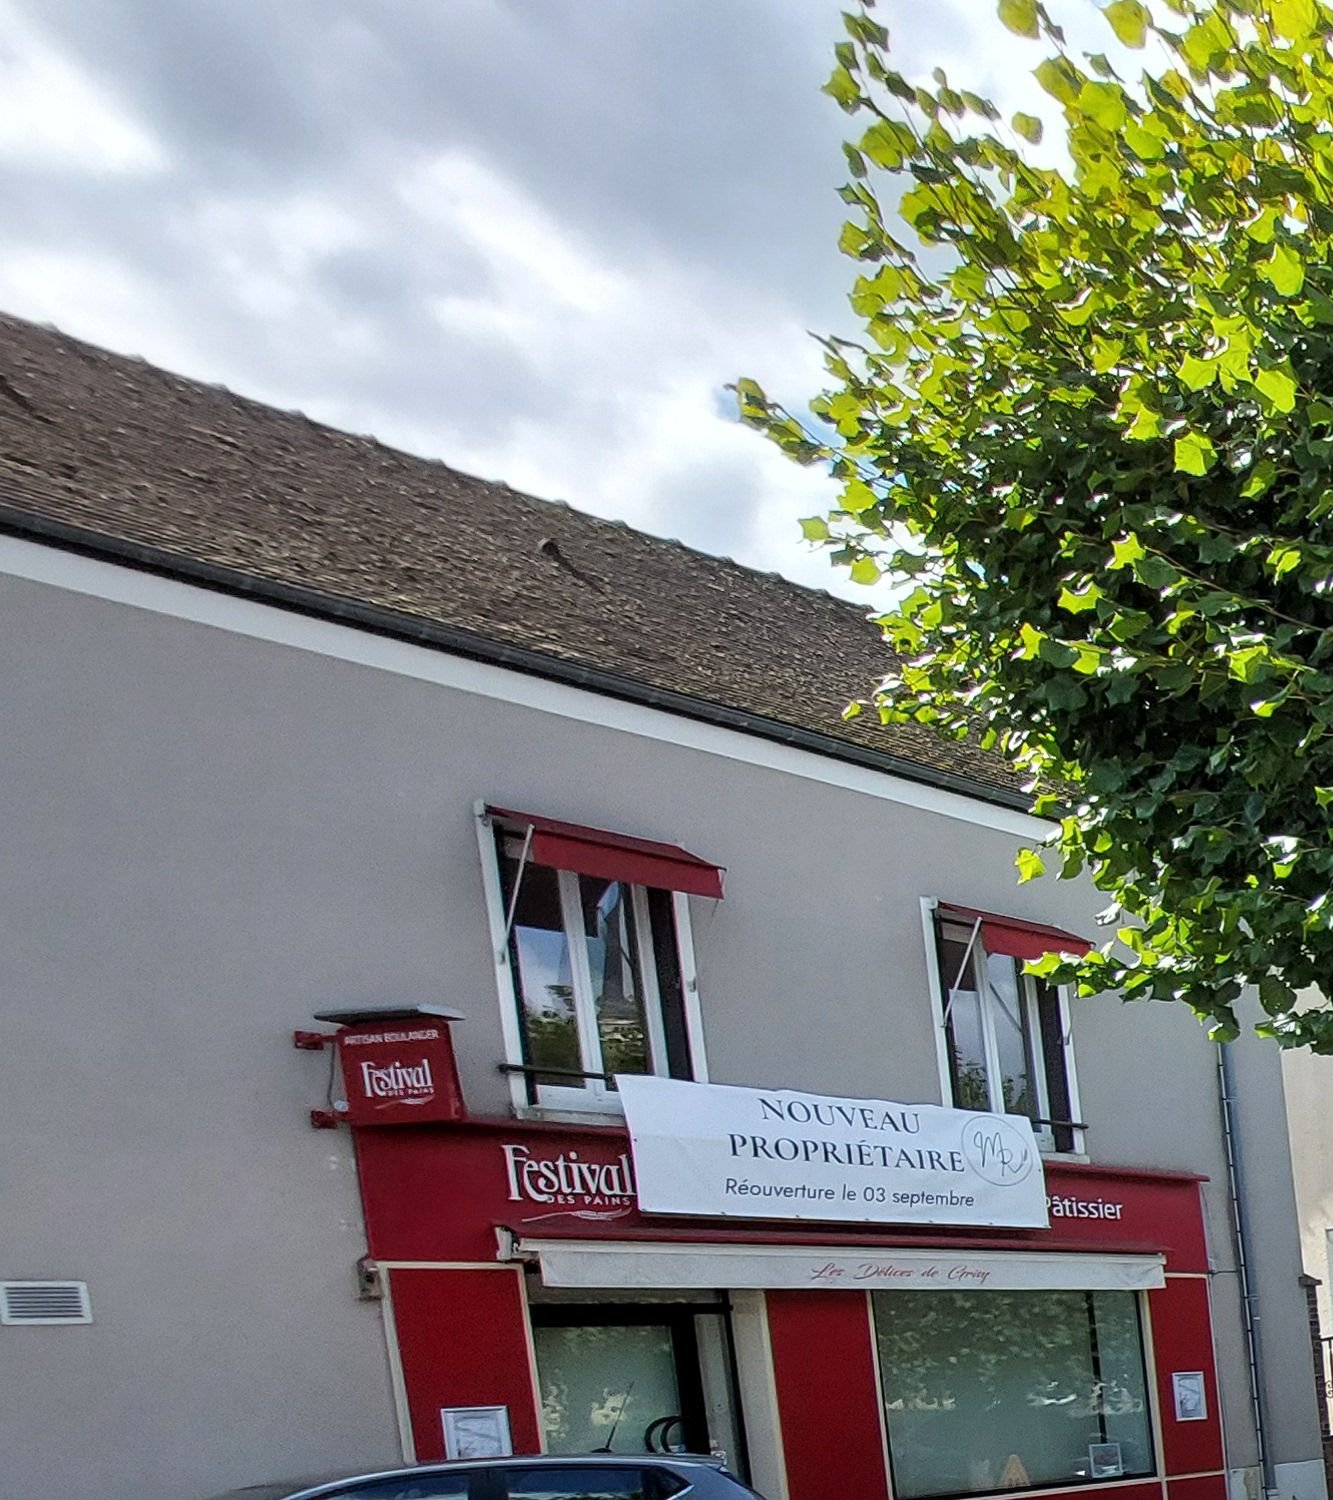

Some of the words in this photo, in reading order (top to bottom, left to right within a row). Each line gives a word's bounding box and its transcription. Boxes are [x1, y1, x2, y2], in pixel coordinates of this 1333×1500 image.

[345, 1034, 383, 1045] ARTISAN
[384, 1029, 439, 1043] BOULANGER
[360, 1058, 434, 1098] Festival
[758, 1098, 920, 1135] NOUVEAU
[728, 1133, 966, 1173] PROPRIÉTAIRE
[501, 1143, 637, 1202] Festival
[583, 1195, 632, 1207] PAINS
[725, 1178, 836, 1201] Réouverture
[842, 1183, 857, 1201] le
[863, 1186, 886, 1202] 03
[892, 1189, 975, 1209] septembre
[811, 1262, 845, 1281] Les
[853, 1263, 914, 1280] Délices
[921, 1265, 939, 1278] de
[947, 1265, 990, 1285] Grisy
